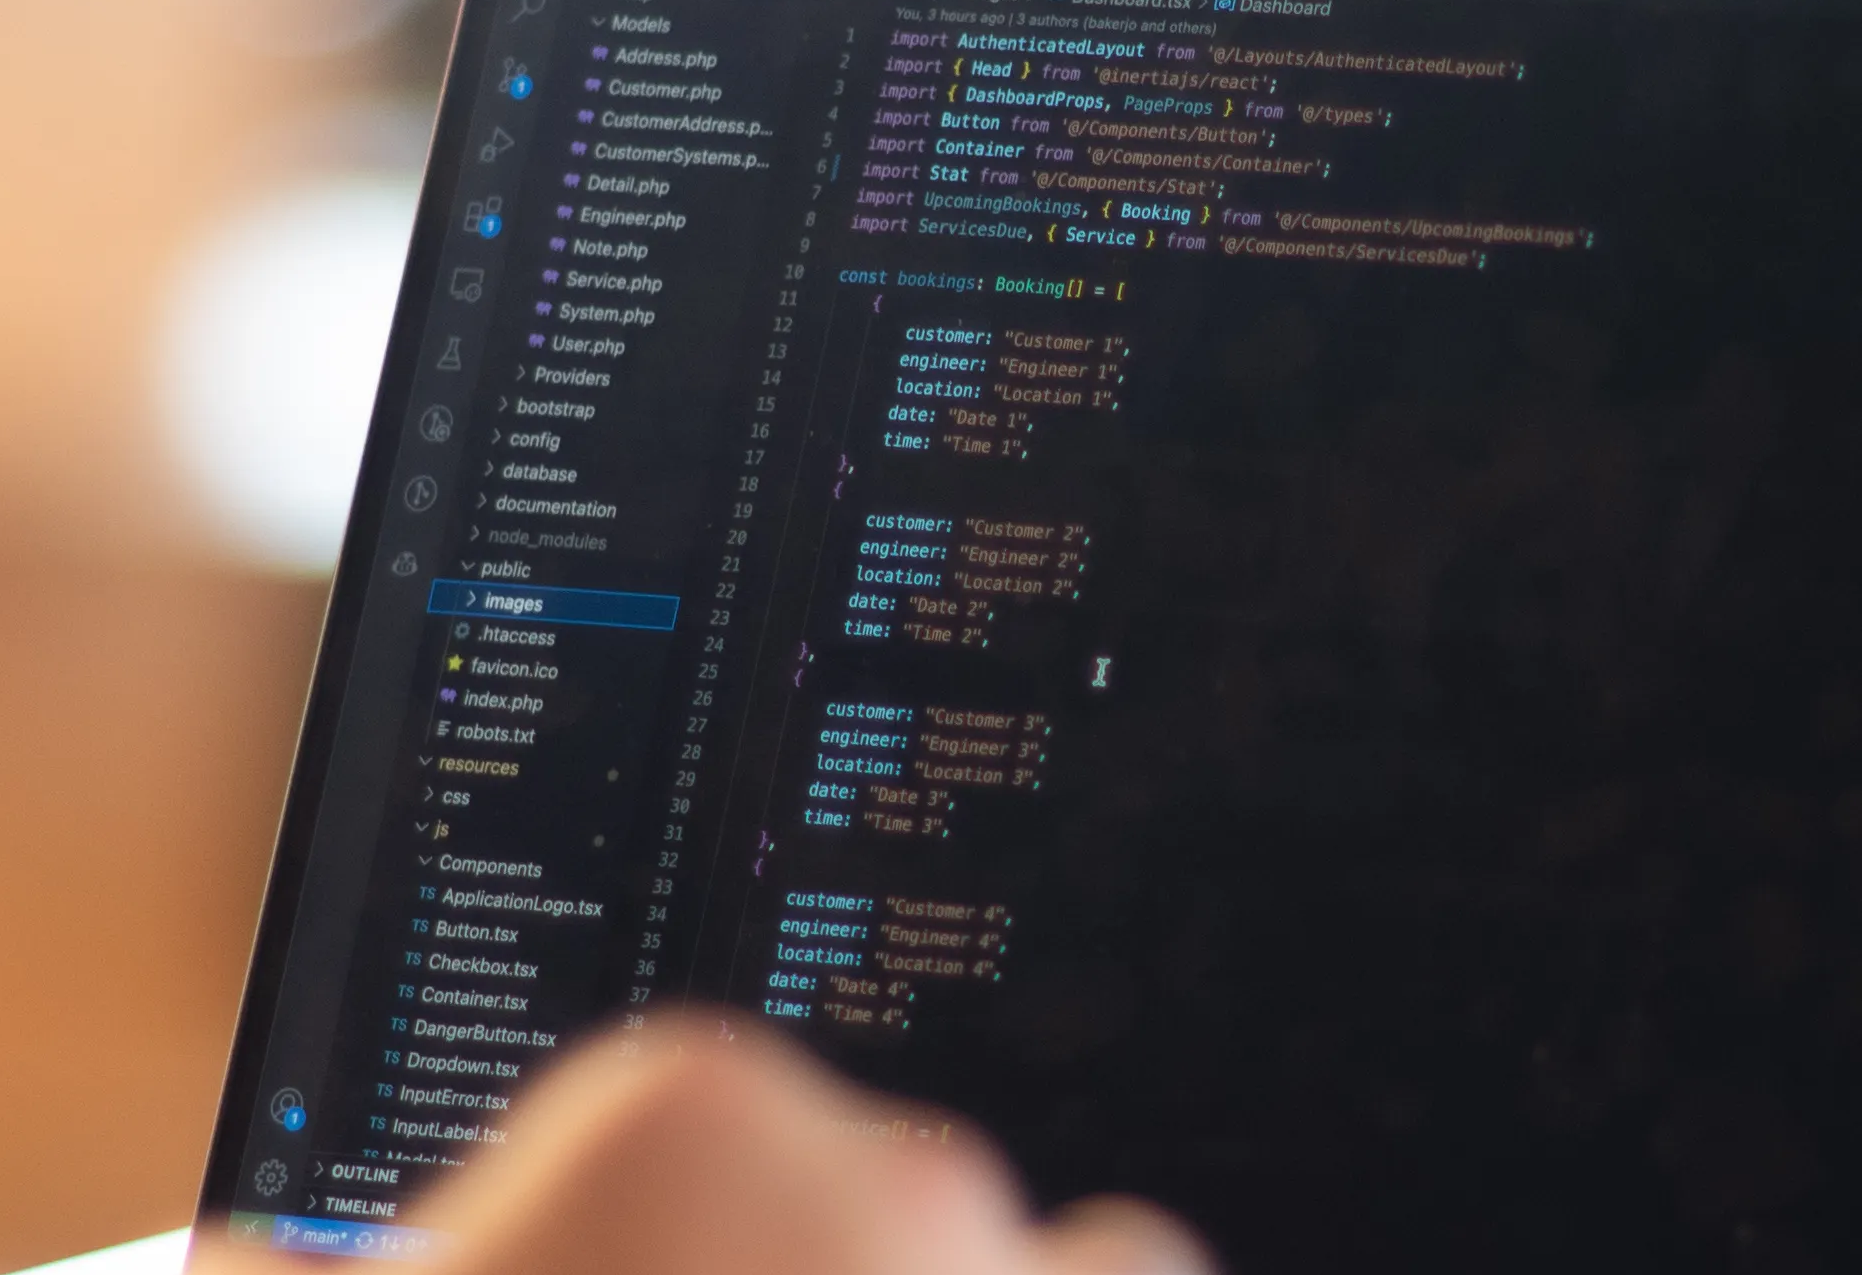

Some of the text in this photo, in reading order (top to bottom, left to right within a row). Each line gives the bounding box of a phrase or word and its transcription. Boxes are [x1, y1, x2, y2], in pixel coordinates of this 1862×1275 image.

[611, 14, 671, 33] Models
[895, 6, 922, 21] You,
[927, 7, 937, 21] 3
[939, 8, 976, 23] hours
[979, 13, 1005, 26] ago
[1016, 12, 1025, 25] 3
[1028, 14, 1078, 27] authors
[1140, 19, 1166, 32] and
[1168, 20, 1217, 37] others)
[614, 47, 717, 70] Address.php
[890, 29, 1525, 80] import AuthenticatedLayout from '@/Layouts/AuthenticatedLayout';
[884, 55, 1277, 94] import Head from '@inertiajs/react';
[607, 78, 722, 102] Customer.php
[878, 82, 1392, 127] import DashboardProps, PageProps from '@/types';
[873, 108, 1276, 148] import Button from '@/Components/Button';
[867, 134, 1331, 178] import Container from '@/Components/Container';
[586, 173, 670, 197] Detail.php
[862, 161, 1224, 199] import Stat from '@/Components/Stat';
[579, 206, 686, 231] Engineer.php
[856, 187, 1594, 249] import UpcomingBookings, Booking from '@/Components/UpcomingBookings';
[573, 238, 648, 261] Note.php
[850, 214, 1486, 270] import ServicesDue, Service from '@/Components/ServicesDue';
[566, 270, 663, 294] Service.php
[838, 269, 1083, 299] const bookings: Booking[]
[558, 302, 655, 327] System.php
[551, 335, 625, 357] User.php
[905, 326, 1130, 357] customer: "Customer 1",
[534, 365, 610, 386] Providers
[899, 353, 1124, 384] engineer: "Engineer 1",
[896, 376, 1119, 411] location: "Location 1",
[516, 397, 595, 421] bootstrap
[887, 404, 1033, 433] date: "Date 1",
[508, 431, 561, 452] config
[883, 431, 1028, 460] time: "Time 1",
[502, 462, 577, 482] database
[494, 494, 617, 518] documentation
[487, 528, 607, 551] node_modules
[865, 514, 1091, 546] customer: "Customer 2",
[859, 540, 1085, 572] engineer: "Engineer 2",
[480, 560, 531, 578] public
[856, 564, 1080, 600] location: "Location 2",
[484, 591, 543, 614] images
[478, 625, 555, 646] .htaccess
[470, 656, 558, 679] favicon.ico
[463, 689, 543, 714] index.php
[825, 702, 1052, 736] customer: "Customer 3",
[456, 723, 536, 744] robots.txt
[819, 729, 1046, 762] engineer: "Engineer 3",
[438, 757, 519, 776] resources
[441, 790, 470, 805] css
[433, 819, 449, 839] js
[438, 853, 542, 878] Components
[441, 887, 603, 917] ApplicationLogo.tsx
[785, 891, 1012, 927] customer: "Customer 4",
[434, 919, 518, 942] Button.tsx
[779, 919, 1007, 954] engineer: "Engineer 4",
[428, 952, 538, 978] Checkbox.tsx
[421, 985, 528, 1011] Container.tsx
[768, 970, 915, 1002] date: "Date 4",
[764, 999, 910, 1030] time: "Time 4",
[413, 1018, 556, 1046] DangerButton.tsx
[406, 1051, 519, 1077] Dropdown.tsx
[399, 1084, 509, 1109] InputError.tsx
[391, 1117, 507, 1142] InputLabel.tsx
[331, 1163, 399, 1183] OUTLINE
[325, 1196, 396, 1216] TIMELINE
